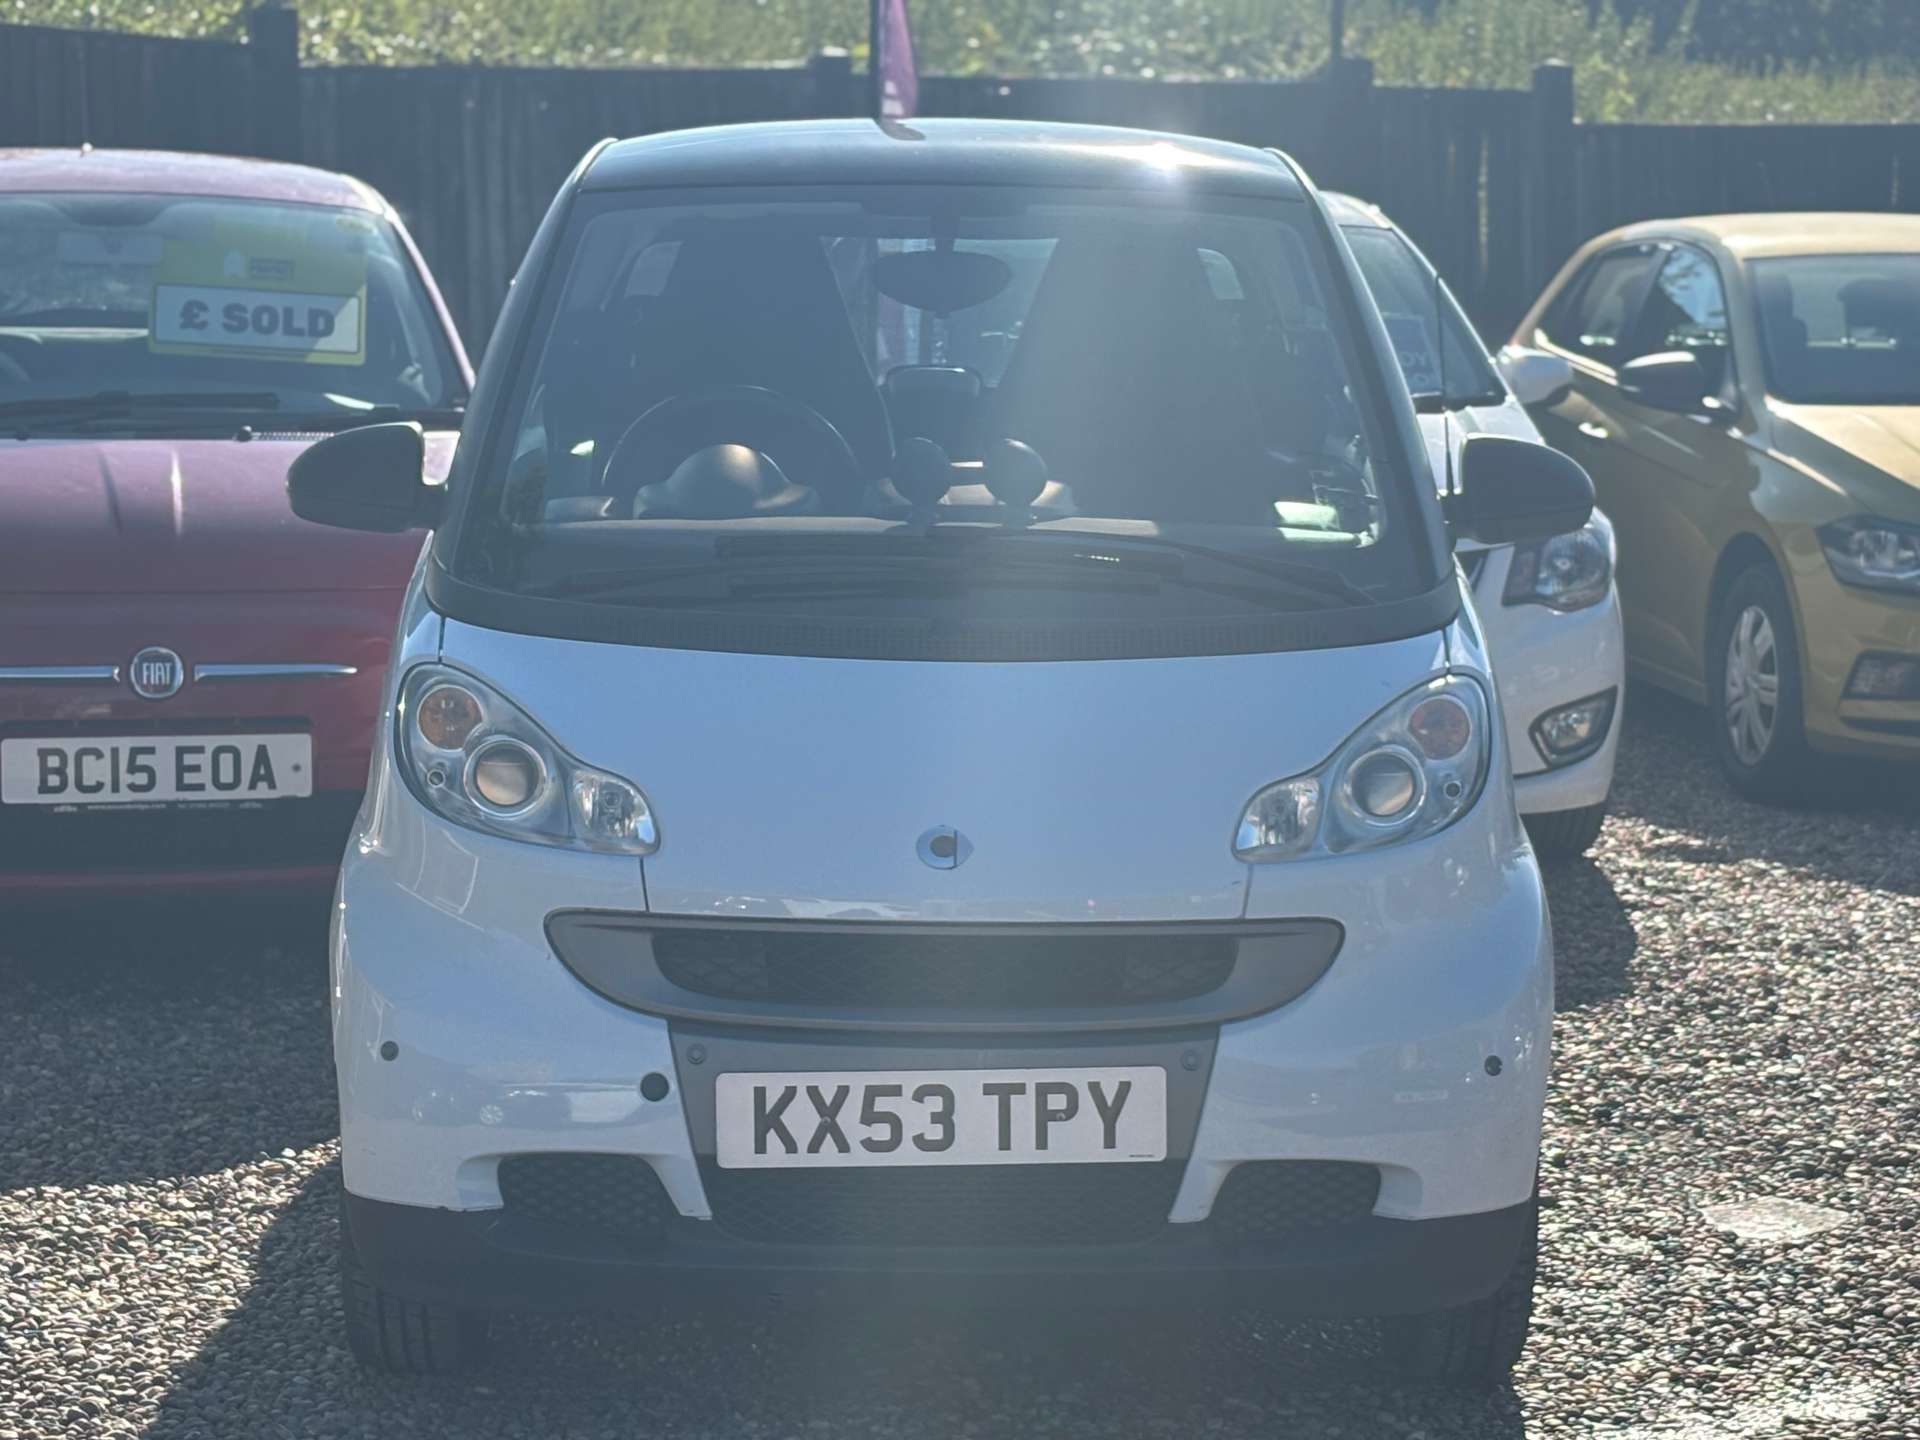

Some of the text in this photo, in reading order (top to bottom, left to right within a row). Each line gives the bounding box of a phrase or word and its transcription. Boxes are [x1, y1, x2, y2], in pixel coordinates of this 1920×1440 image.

[179, 299, 336, 338] £ SOLD
[142, 662, 173, 685] FIAT
[37, 744, 278, 795] BC15 EOA
[753, 1080, 1133, 1155] KX53 TPY
